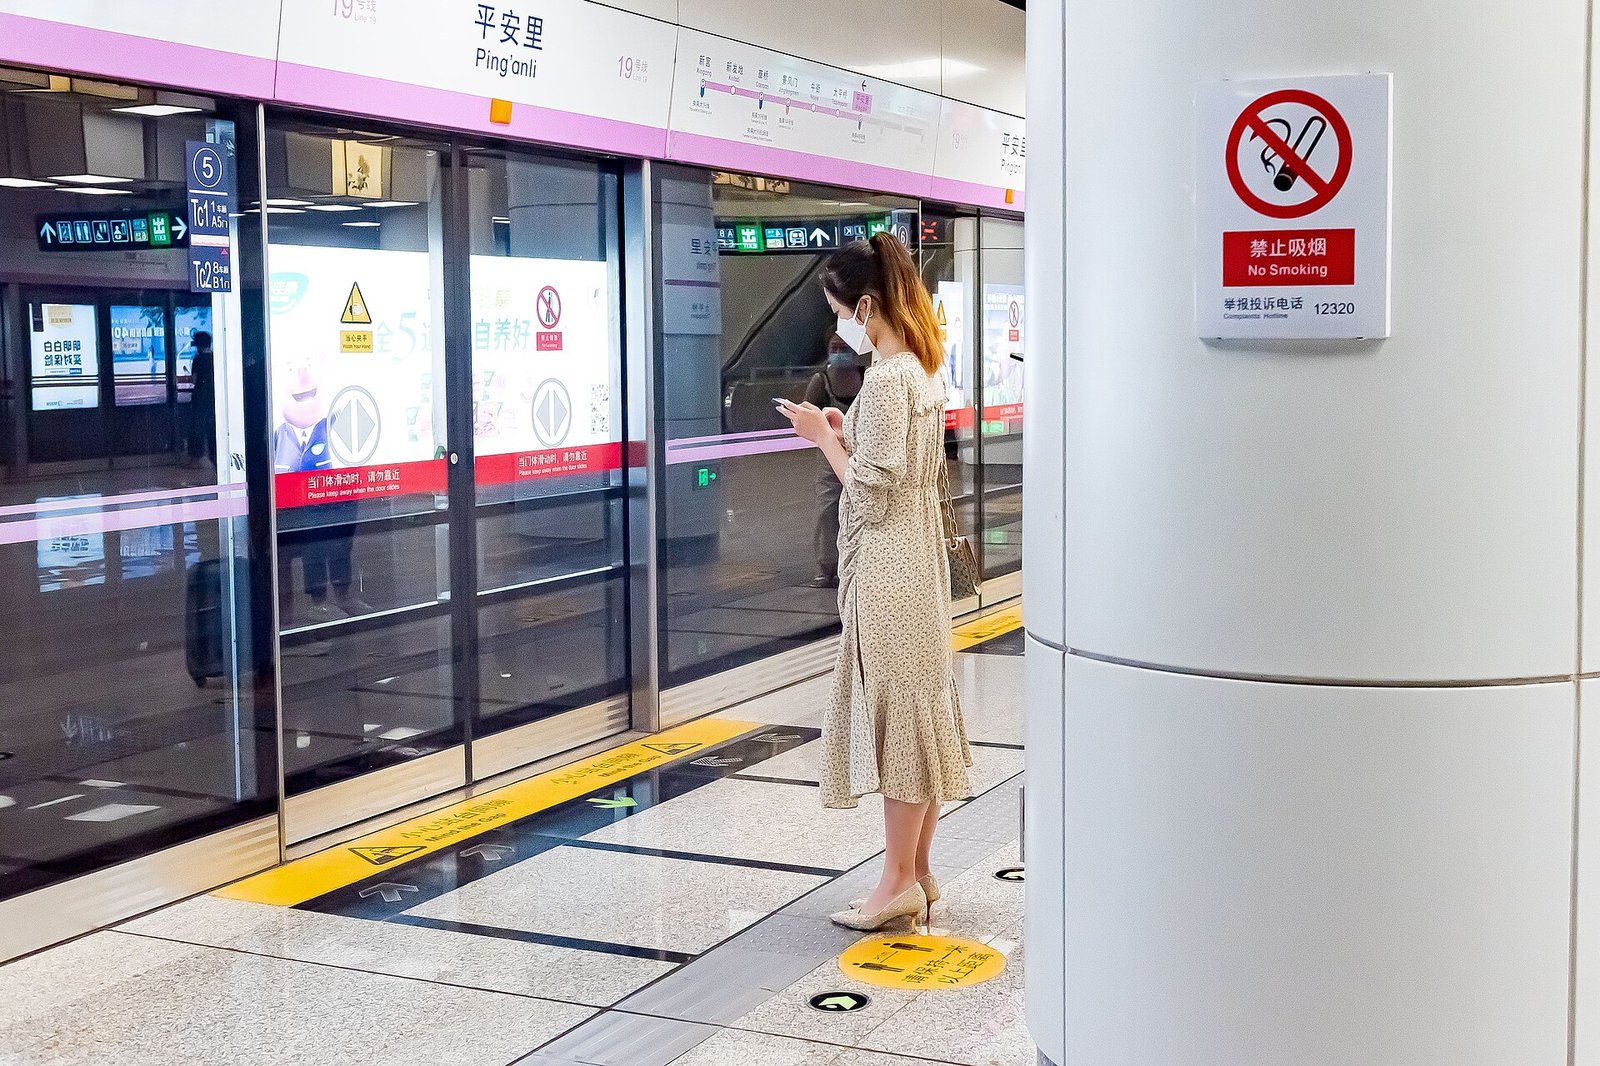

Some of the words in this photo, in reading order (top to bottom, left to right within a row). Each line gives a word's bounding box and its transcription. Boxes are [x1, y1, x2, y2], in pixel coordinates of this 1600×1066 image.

[474, 4, 543, 50] 平安里
[475, 48, 537, 78] Ping'anli
[202, 156, 214, 179] 5
[190, 198, 209, 228] Tc1
[1250, 238, 1327, 257] 禁止吸烟
[192, 260, 213, 289] Tc2
[1248, 264, 1266, 276] No
[1269, 263, 1328, 277] Smoking
[1224, 296, 1303, 311] 举报投诉电话
[1314, 302, 1355, 315] 12320
[475, 317, 532, 352] 自养好
[308, 491, 325, 499] Please
